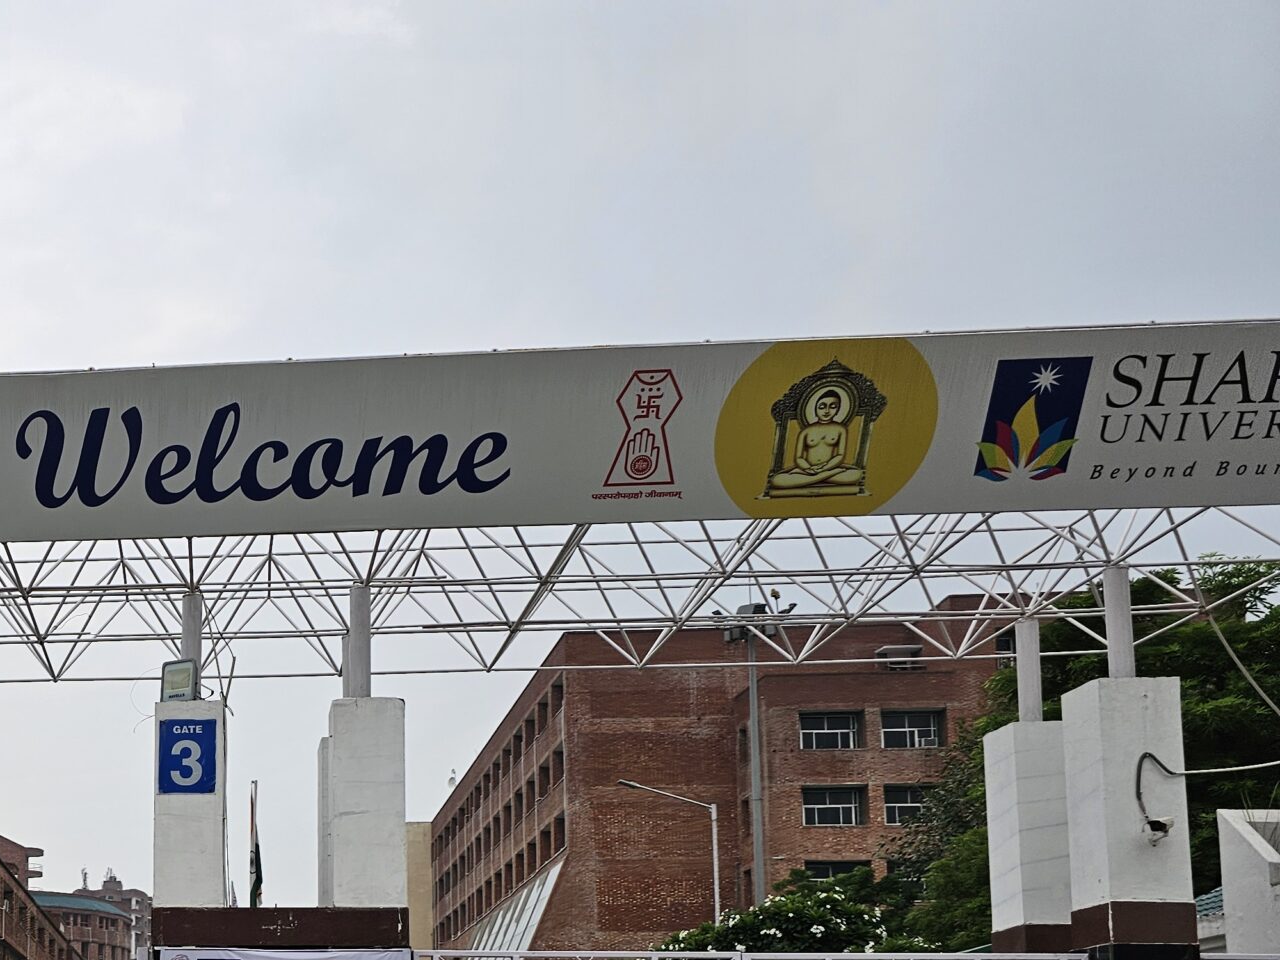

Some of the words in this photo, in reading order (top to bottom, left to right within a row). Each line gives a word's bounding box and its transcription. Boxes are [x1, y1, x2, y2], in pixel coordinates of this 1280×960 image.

[16, 402, 511, 508] Welcome
[1090, 461, 1197, 482] Beyond
[172, 725, 203, 734] GATE
[170, 739, 203, 786] 3
